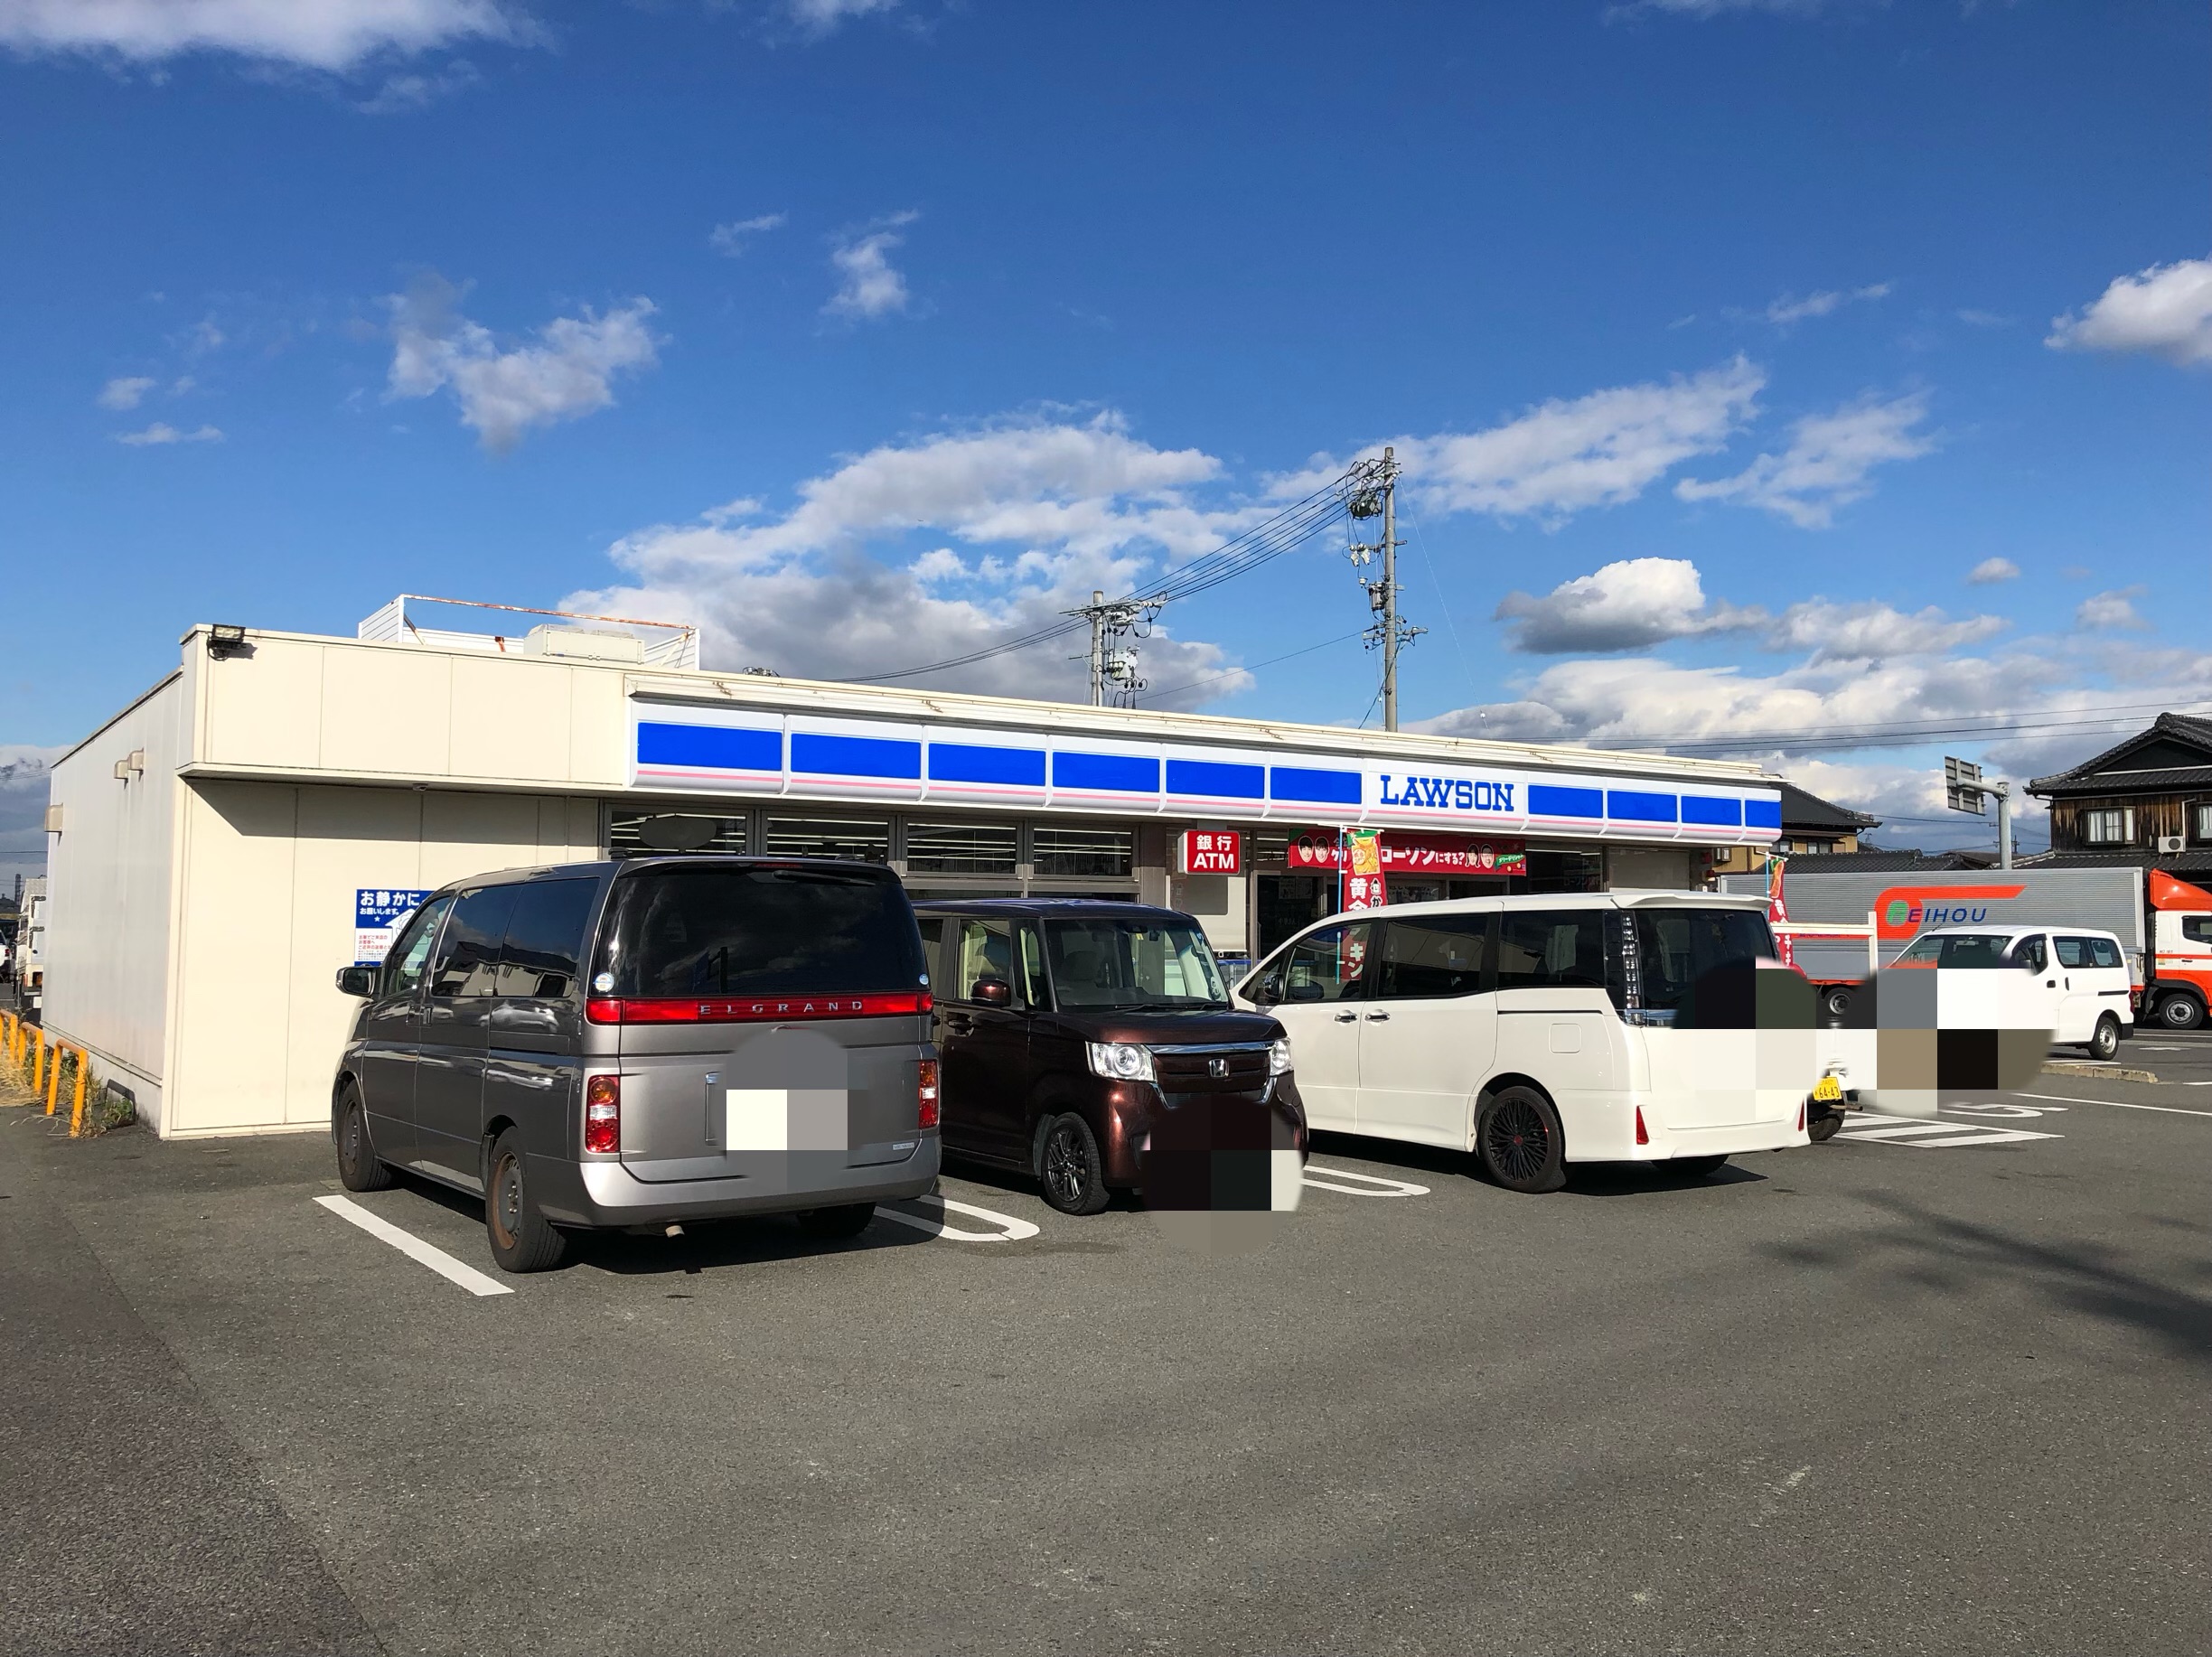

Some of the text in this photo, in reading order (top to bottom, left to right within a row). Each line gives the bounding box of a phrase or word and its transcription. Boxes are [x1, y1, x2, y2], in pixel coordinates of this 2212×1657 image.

[1380, 774, 1514, 812] LAWSON
[1195, 834, 1233, 852] 銀行
[1193, 852, 1235, 869] ATM
[360, 891, 420, 906] お静かに
[700, 1000, 863, 1016] ELGRAND
